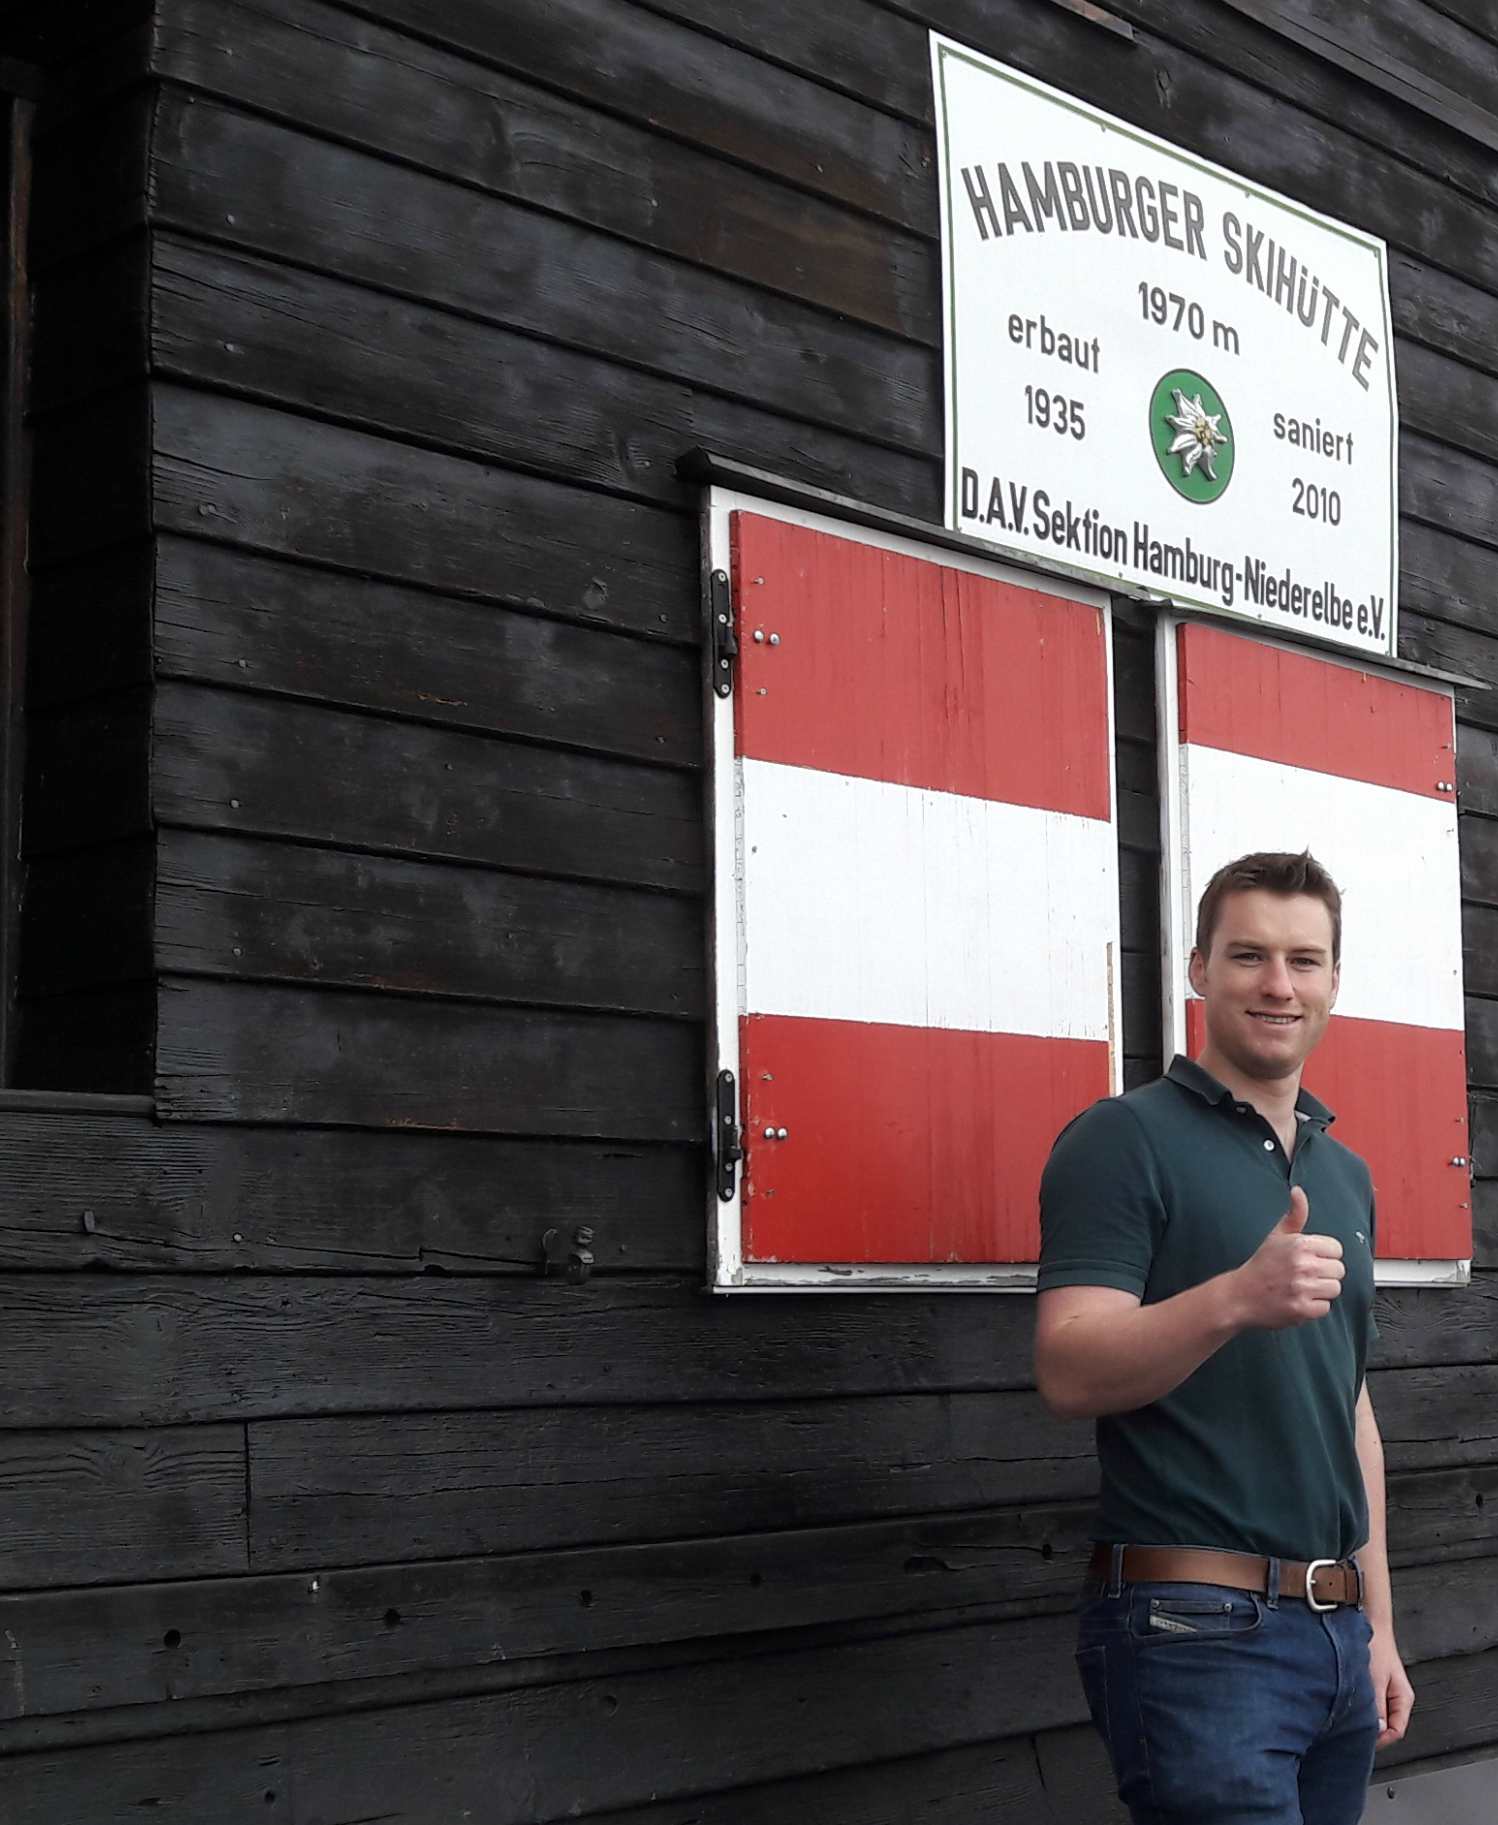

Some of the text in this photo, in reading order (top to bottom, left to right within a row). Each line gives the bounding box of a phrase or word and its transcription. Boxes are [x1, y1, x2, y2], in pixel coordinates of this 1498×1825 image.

[960, 160, 1207, 261] HAMBURGER
[1008, 314, 1101, 374] erbaut
[1138, 281, 1240, 355] 1970 m
[1024, 384, 1086, 441] 1935
[1273, 412, 1354, 465] saniert
[1291, 477, 1341, 527] 2010
[1133, 520, 1353, 631] Hamburg-Niederelbe
[1357, 594, 1386, 641] e.V.
